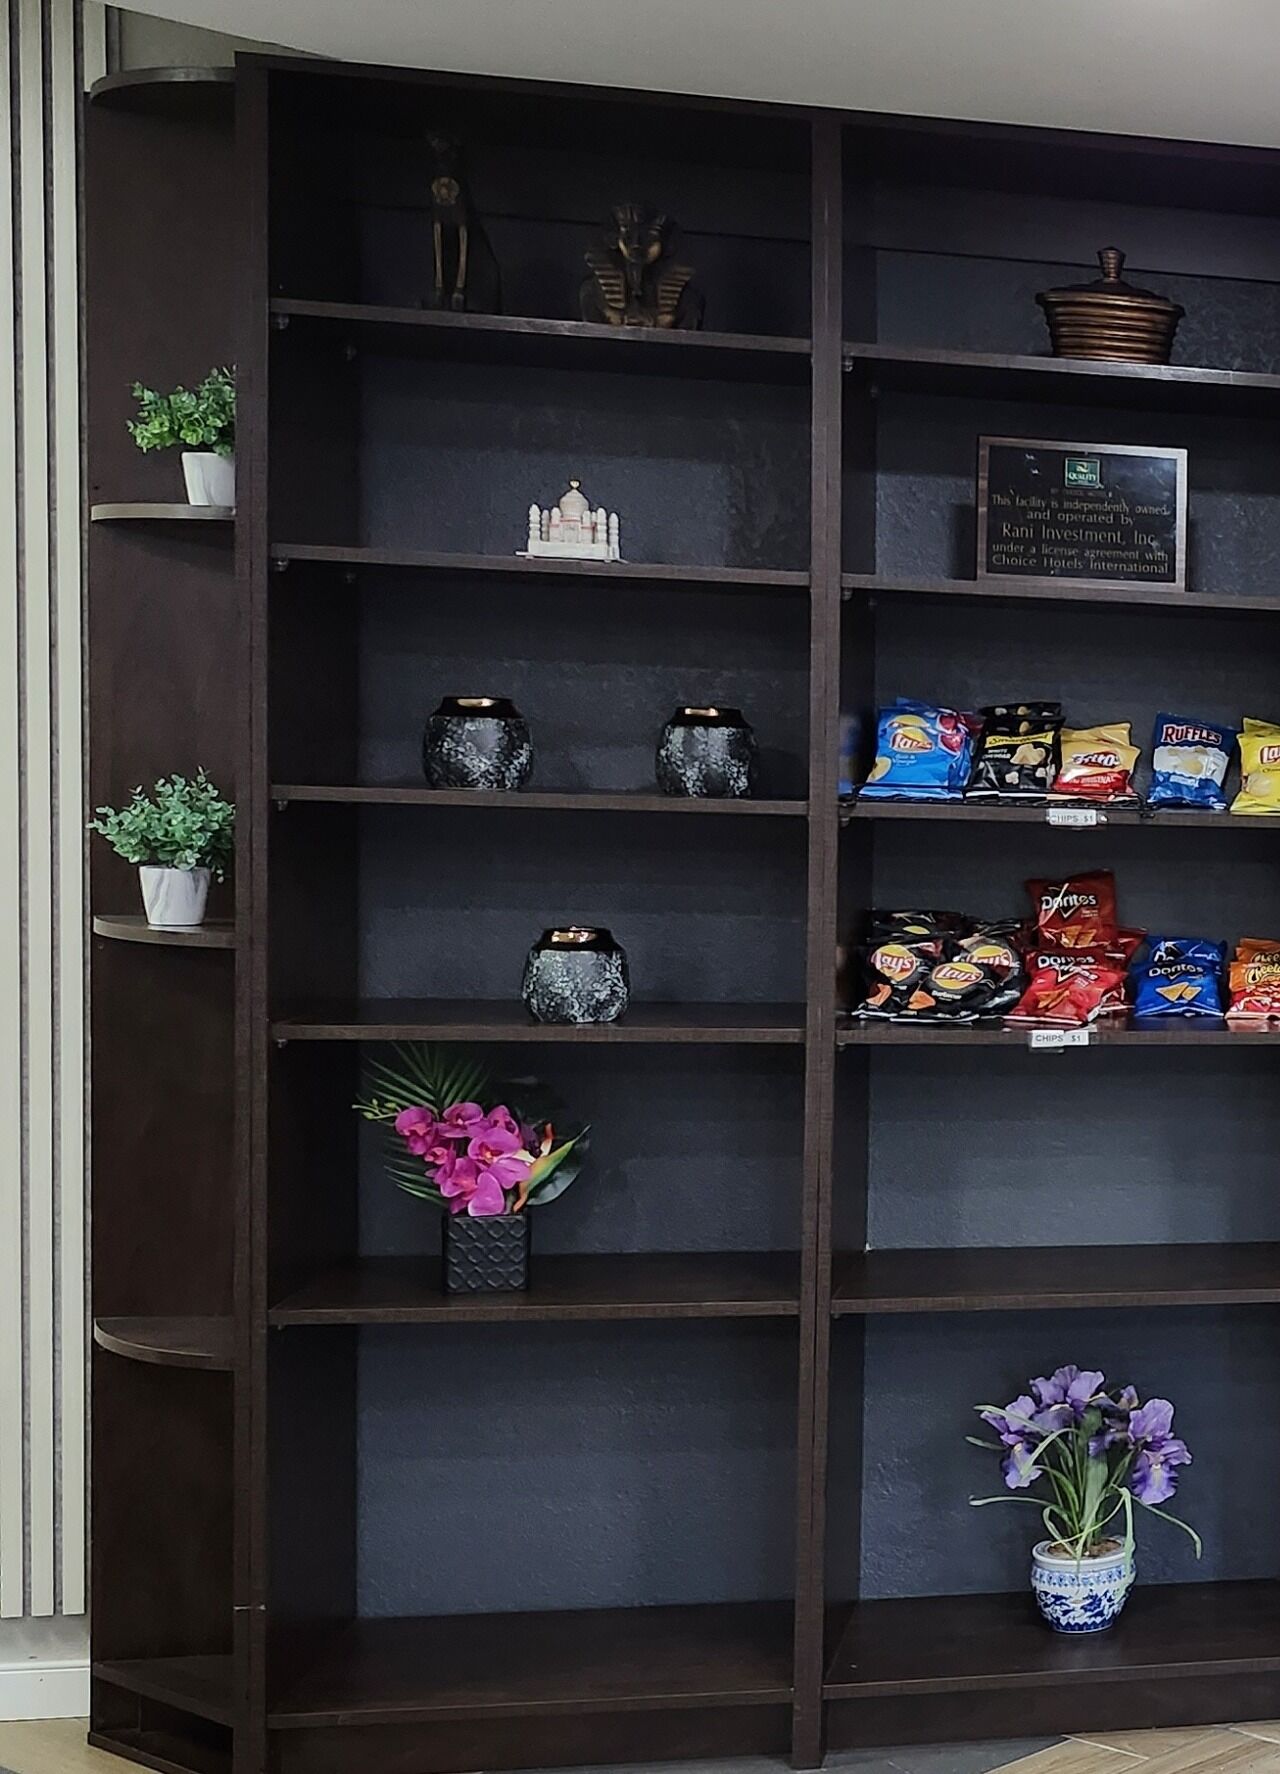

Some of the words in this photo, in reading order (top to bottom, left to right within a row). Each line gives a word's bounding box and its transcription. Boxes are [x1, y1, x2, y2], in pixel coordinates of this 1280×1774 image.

[1068, 471, 1096, 481] QUALITY
[992, 494, 1011, 506] This
[1015, 496, 1046, 511] facility
[1050, 500, 1059, 509] is
[1063, 499, 1130, 516] independently
[1135, 504, 1167, 515] owned
[1026, 509, 1051, 520] and
[1057, 511, 1113, 524] operated
[1121, 512, 1134, 527] by
[1002, 522, 1034, 539] Rani
[992, 542, 1025, 554] under
[1030, 546, 1037, 554] a
[1041, 543, 1079, 556] license
[1083, 549, 1139, 561] agreement
[1144, 550, 1169, 562] with
[992, 554, 1037, 567] Choice
[1043, 556, 1083, 569] Hotels
[1089, 559, 1168, 574] International
[1161, 724, 1223, 745] RUFFLES
[1050, 814, 1079, 824] CHIPS
[1041, 893, 1097, 911] Doritos
[1035, 1033, 1064, 1043] CHIPS
[1070, 1033, 1082, 1043] $1
